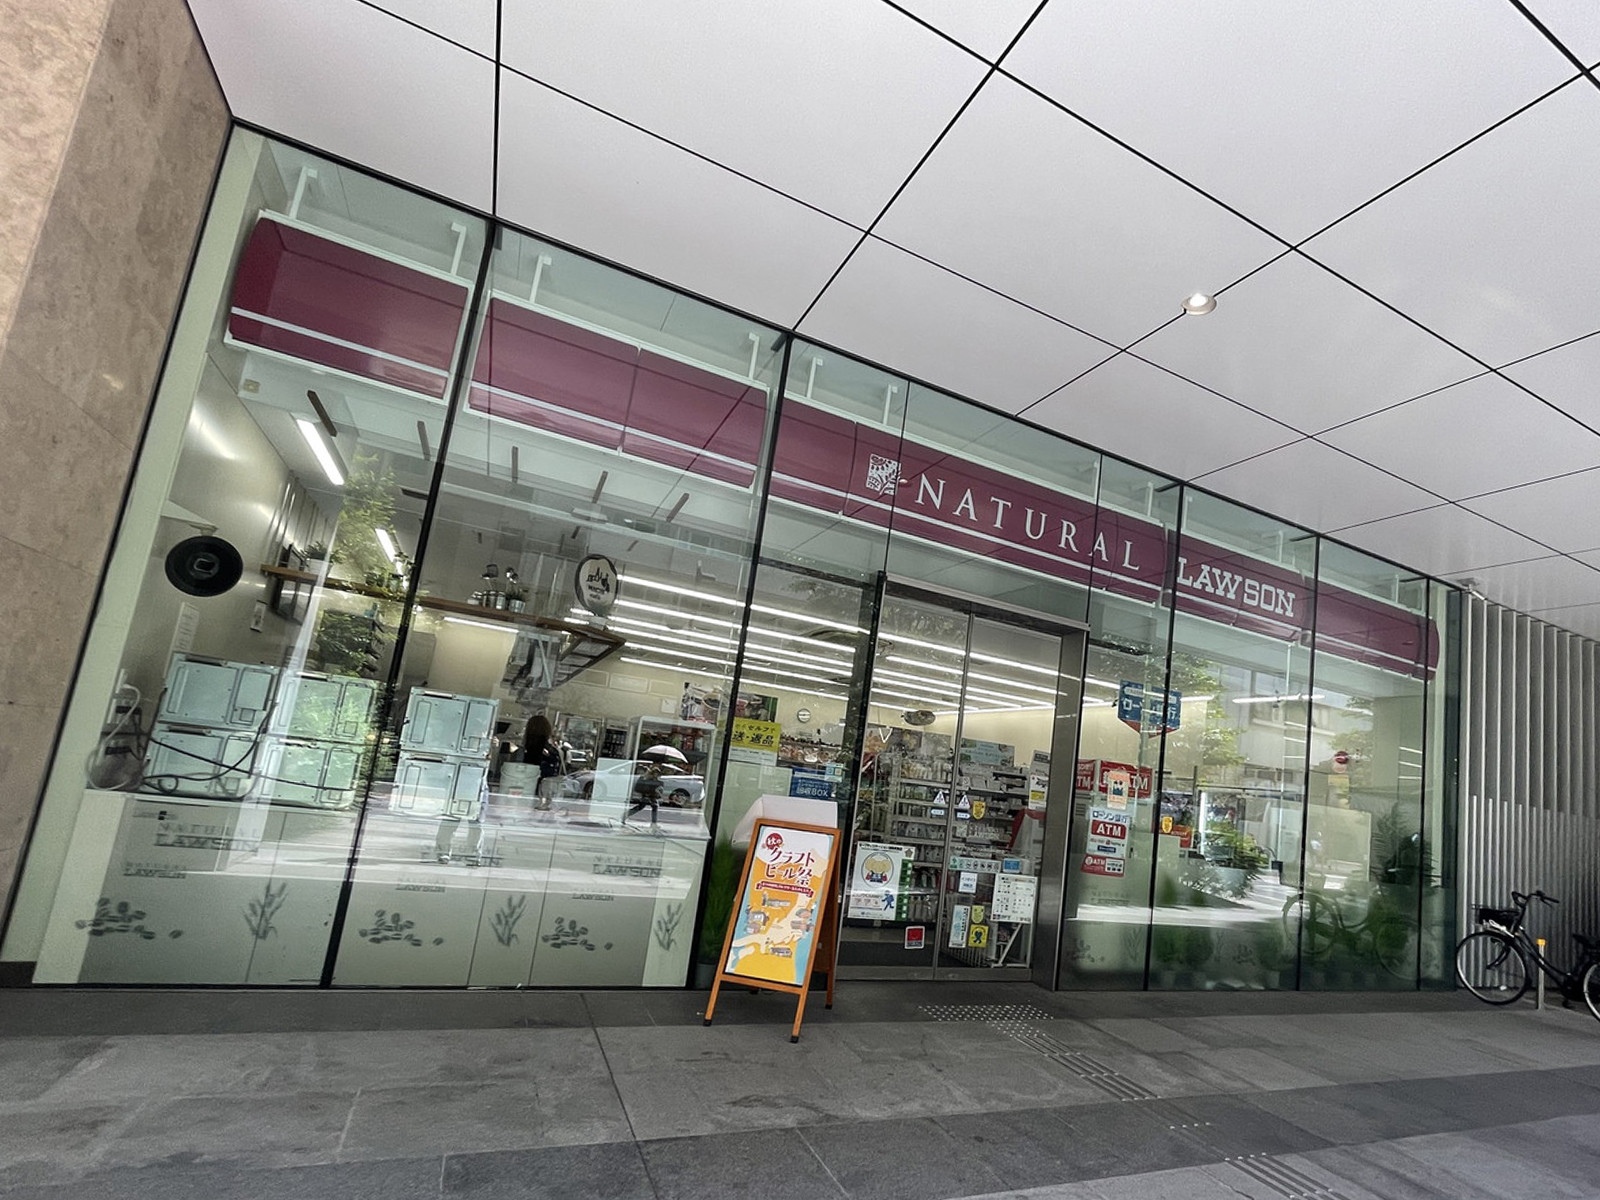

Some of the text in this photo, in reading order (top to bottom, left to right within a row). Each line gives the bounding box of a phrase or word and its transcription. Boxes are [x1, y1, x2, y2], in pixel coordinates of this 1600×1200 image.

[915, 473, 1296, 618] NATURAL LAWSON
[1096, 823, 1121, 837] ATM
[770, 847, 815, 866] クラフト
[766, 862, 813, 886] ビール祭
